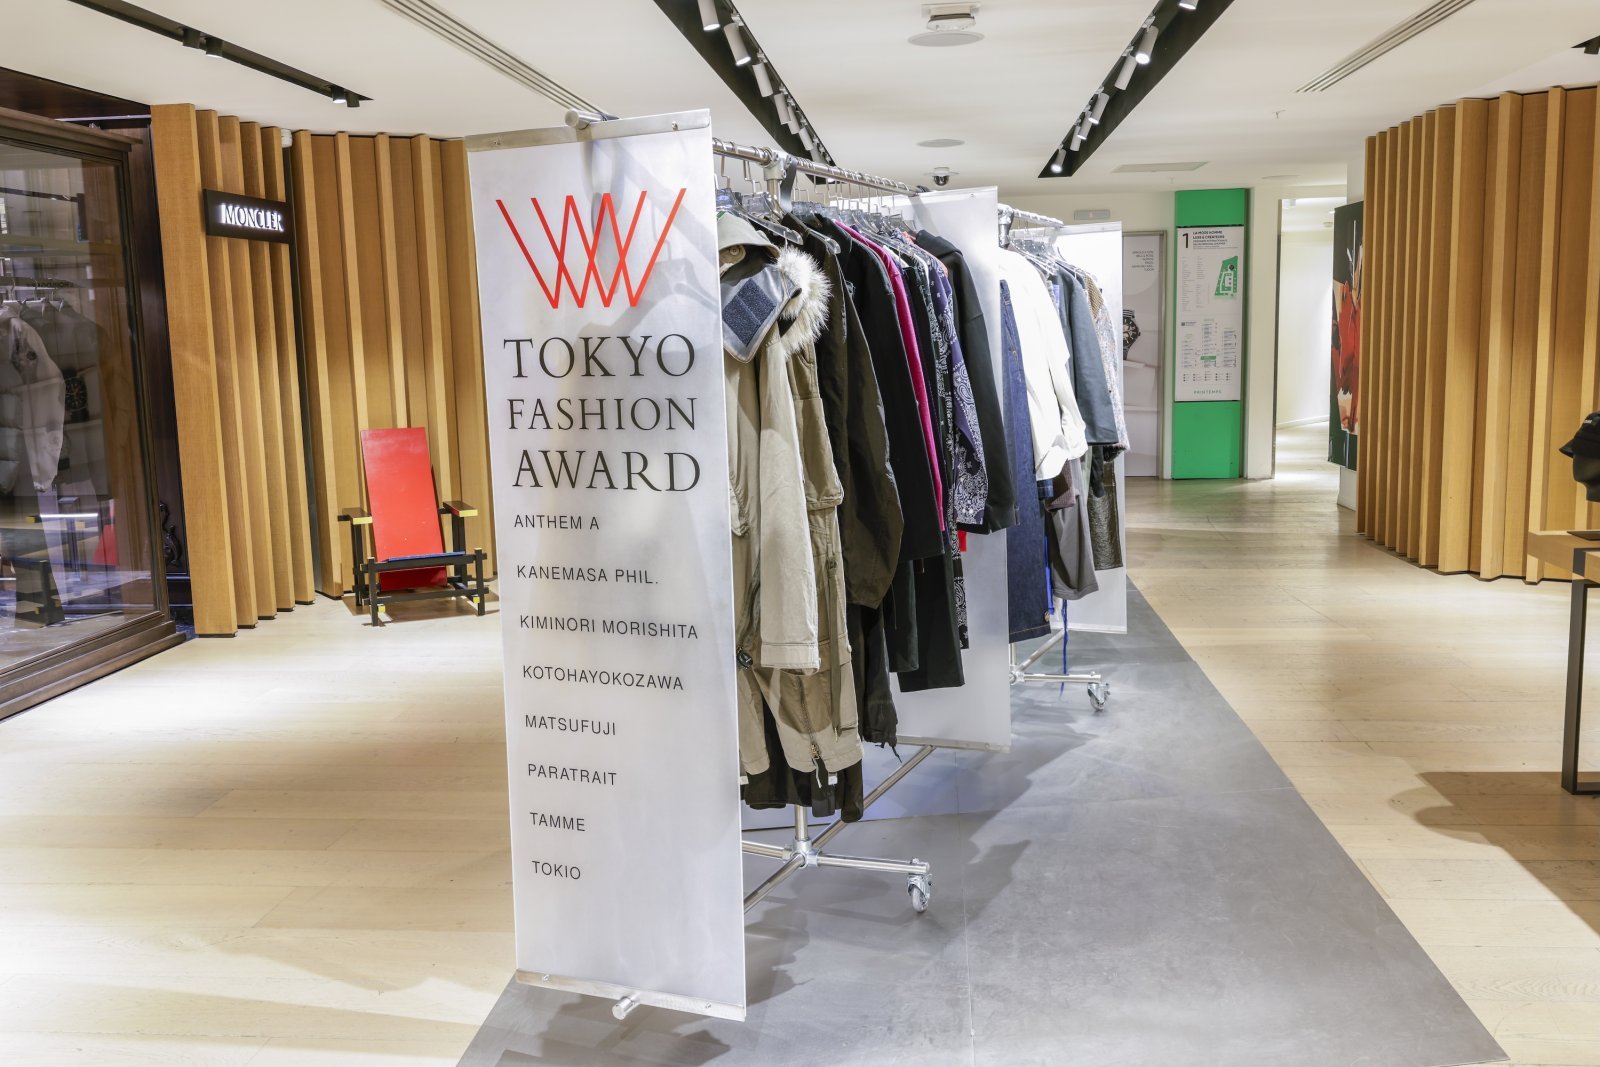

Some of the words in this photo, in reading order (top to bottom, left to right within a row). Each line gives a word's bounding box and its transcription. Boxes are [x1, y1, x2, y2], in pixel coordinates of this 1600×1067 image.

[220, 203, 284, 232] MONCLER
[1182, 233, 1188, 248] 1
[504, 334, 695, 378] TOKYO
[508, 398, 697, 430] FASHION
[512, 450, 700, 491] AWARD
[515, 515, 581, 529] ANTHEM
[590, 517, 599, 530] A
[518, 565, 607, 581] KANEMASA
[616, 569, 658, 584] PHIL.
[521, 616, 594, 632] KIMINORI
[603, 620, 697, 639] MORISHITA
[523, 666, 683, 690] KOTOHAYOKOZAWA
[526, 715, 615, 735] MATSUFUJI
[528, 764, 616, 785] PARATRAIT
[530, 812, 585, 831] TAMME
[532, 861, 580, 879] TOKIO
